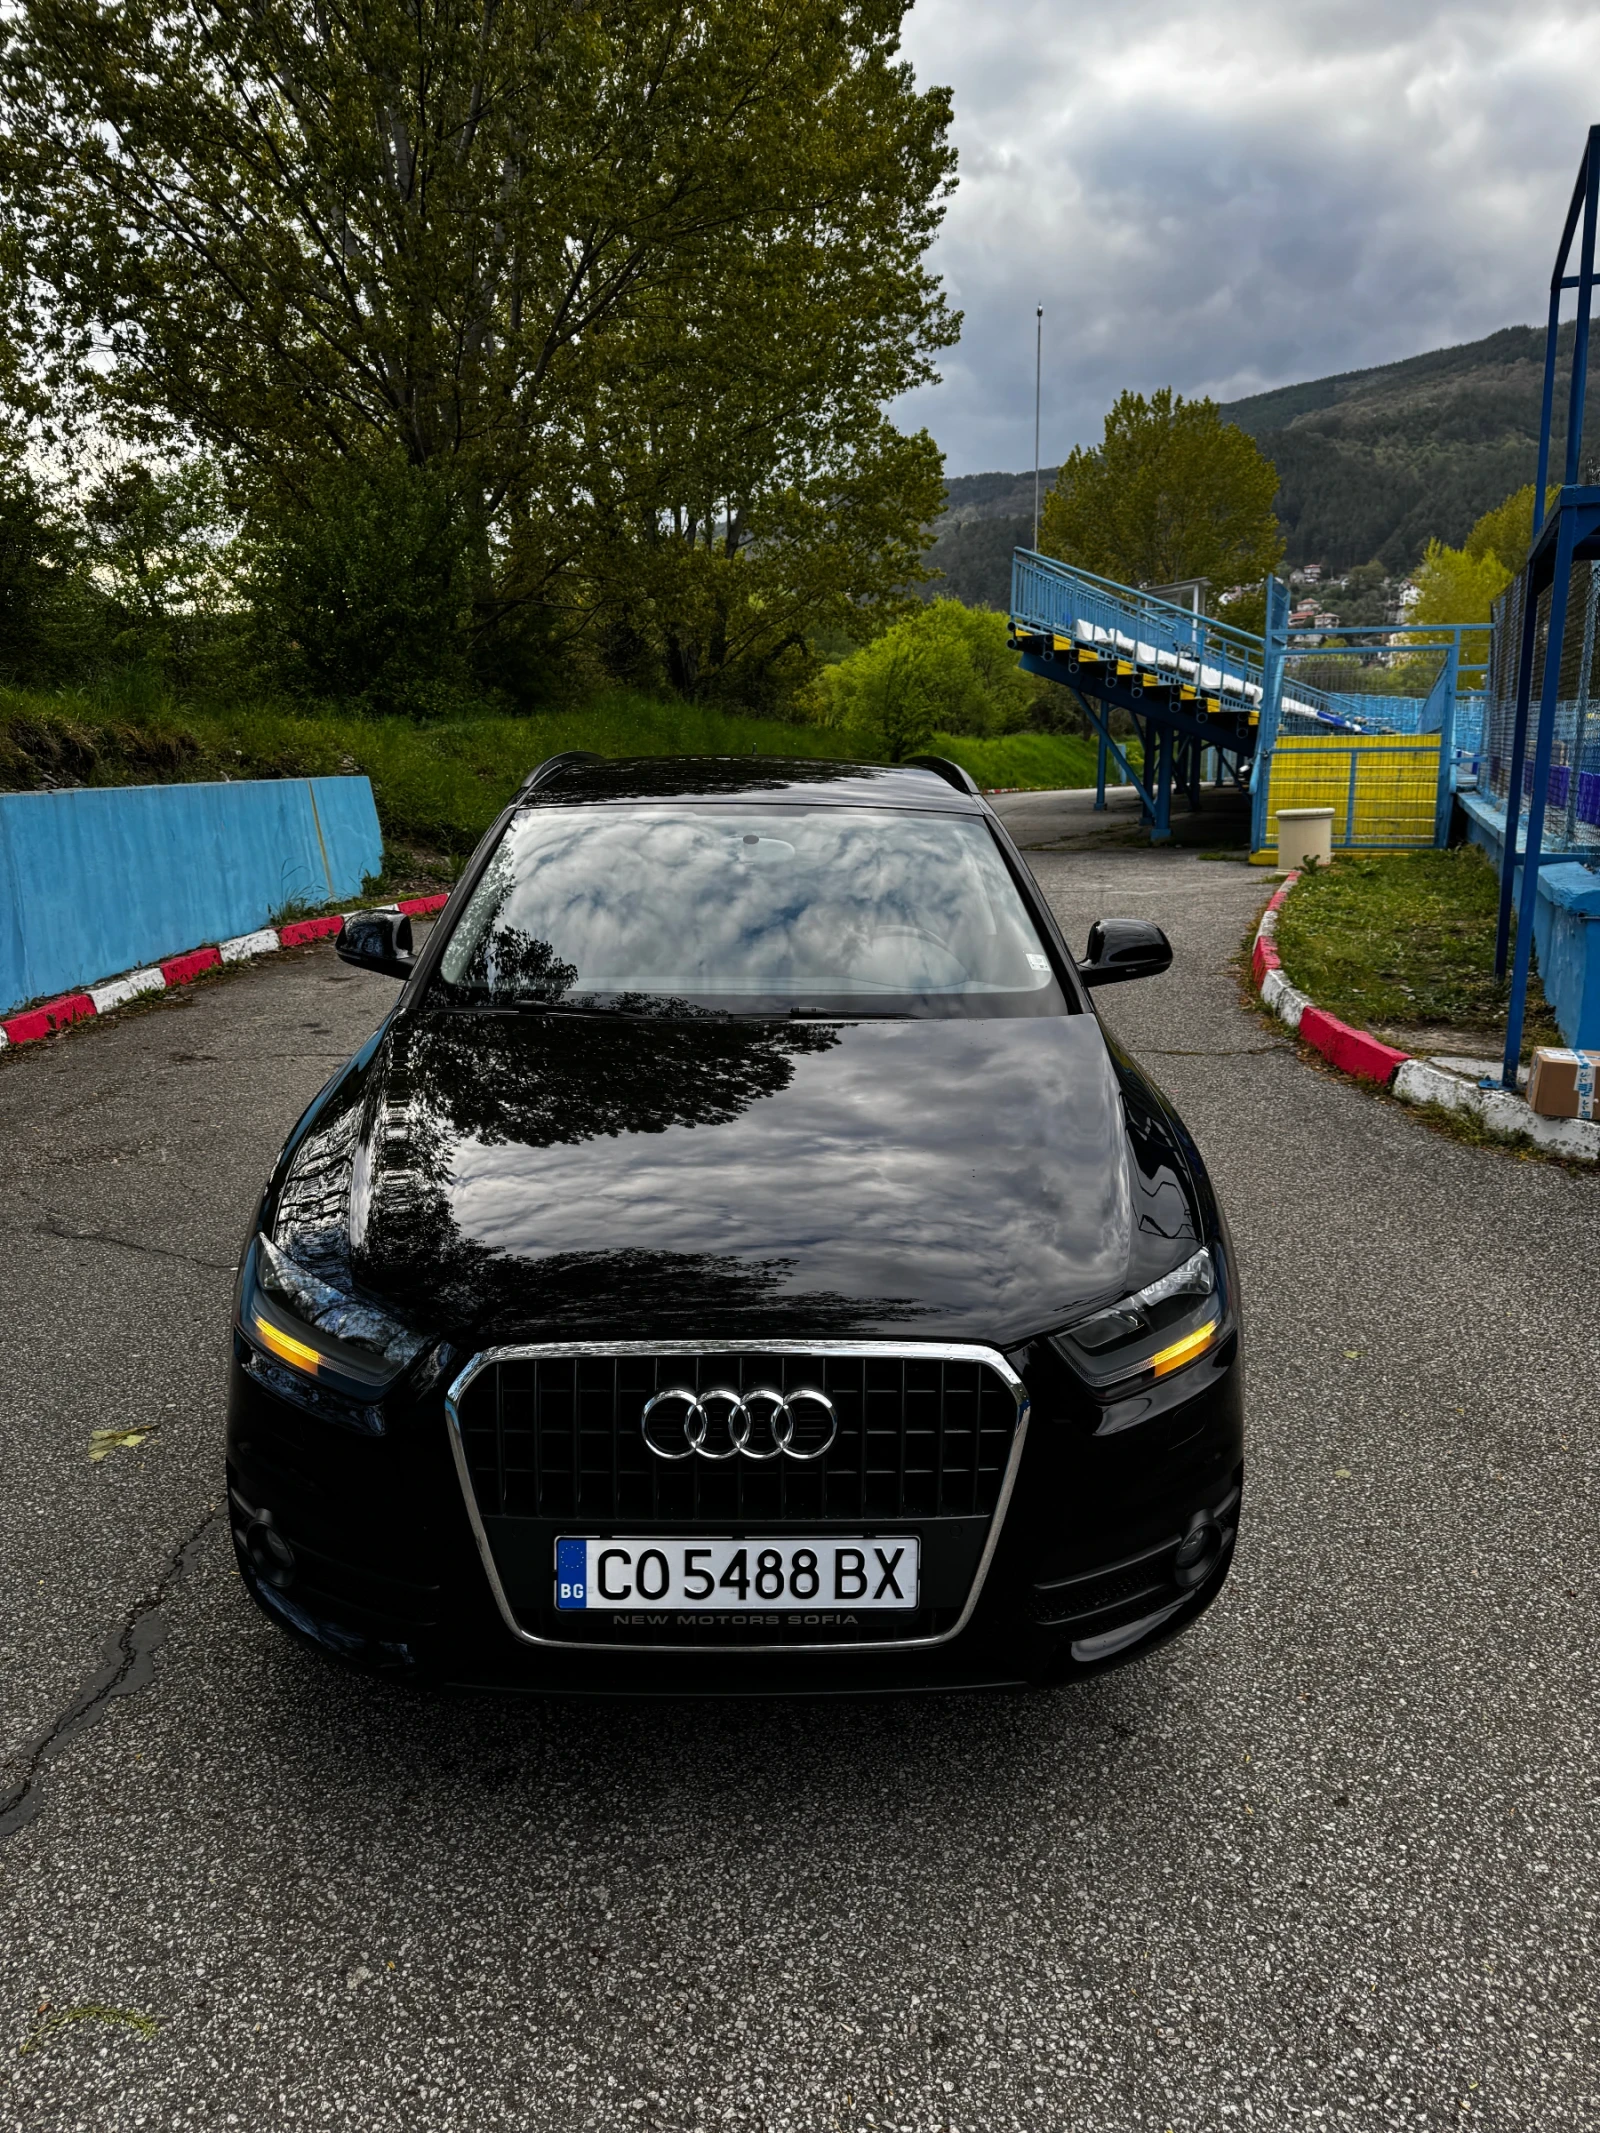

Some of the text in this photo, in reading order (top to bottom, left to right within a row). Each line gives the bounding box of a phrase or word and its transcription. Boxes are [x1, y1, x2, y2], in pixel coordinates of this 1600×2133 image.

[683, 1548, 819, 1600] 5488
[834, 1547, 905, 1600] BX
[560, 1583, 584, 1599] BG
[612, 1613, 859, 1625] NEW MOTORS SOFIA
